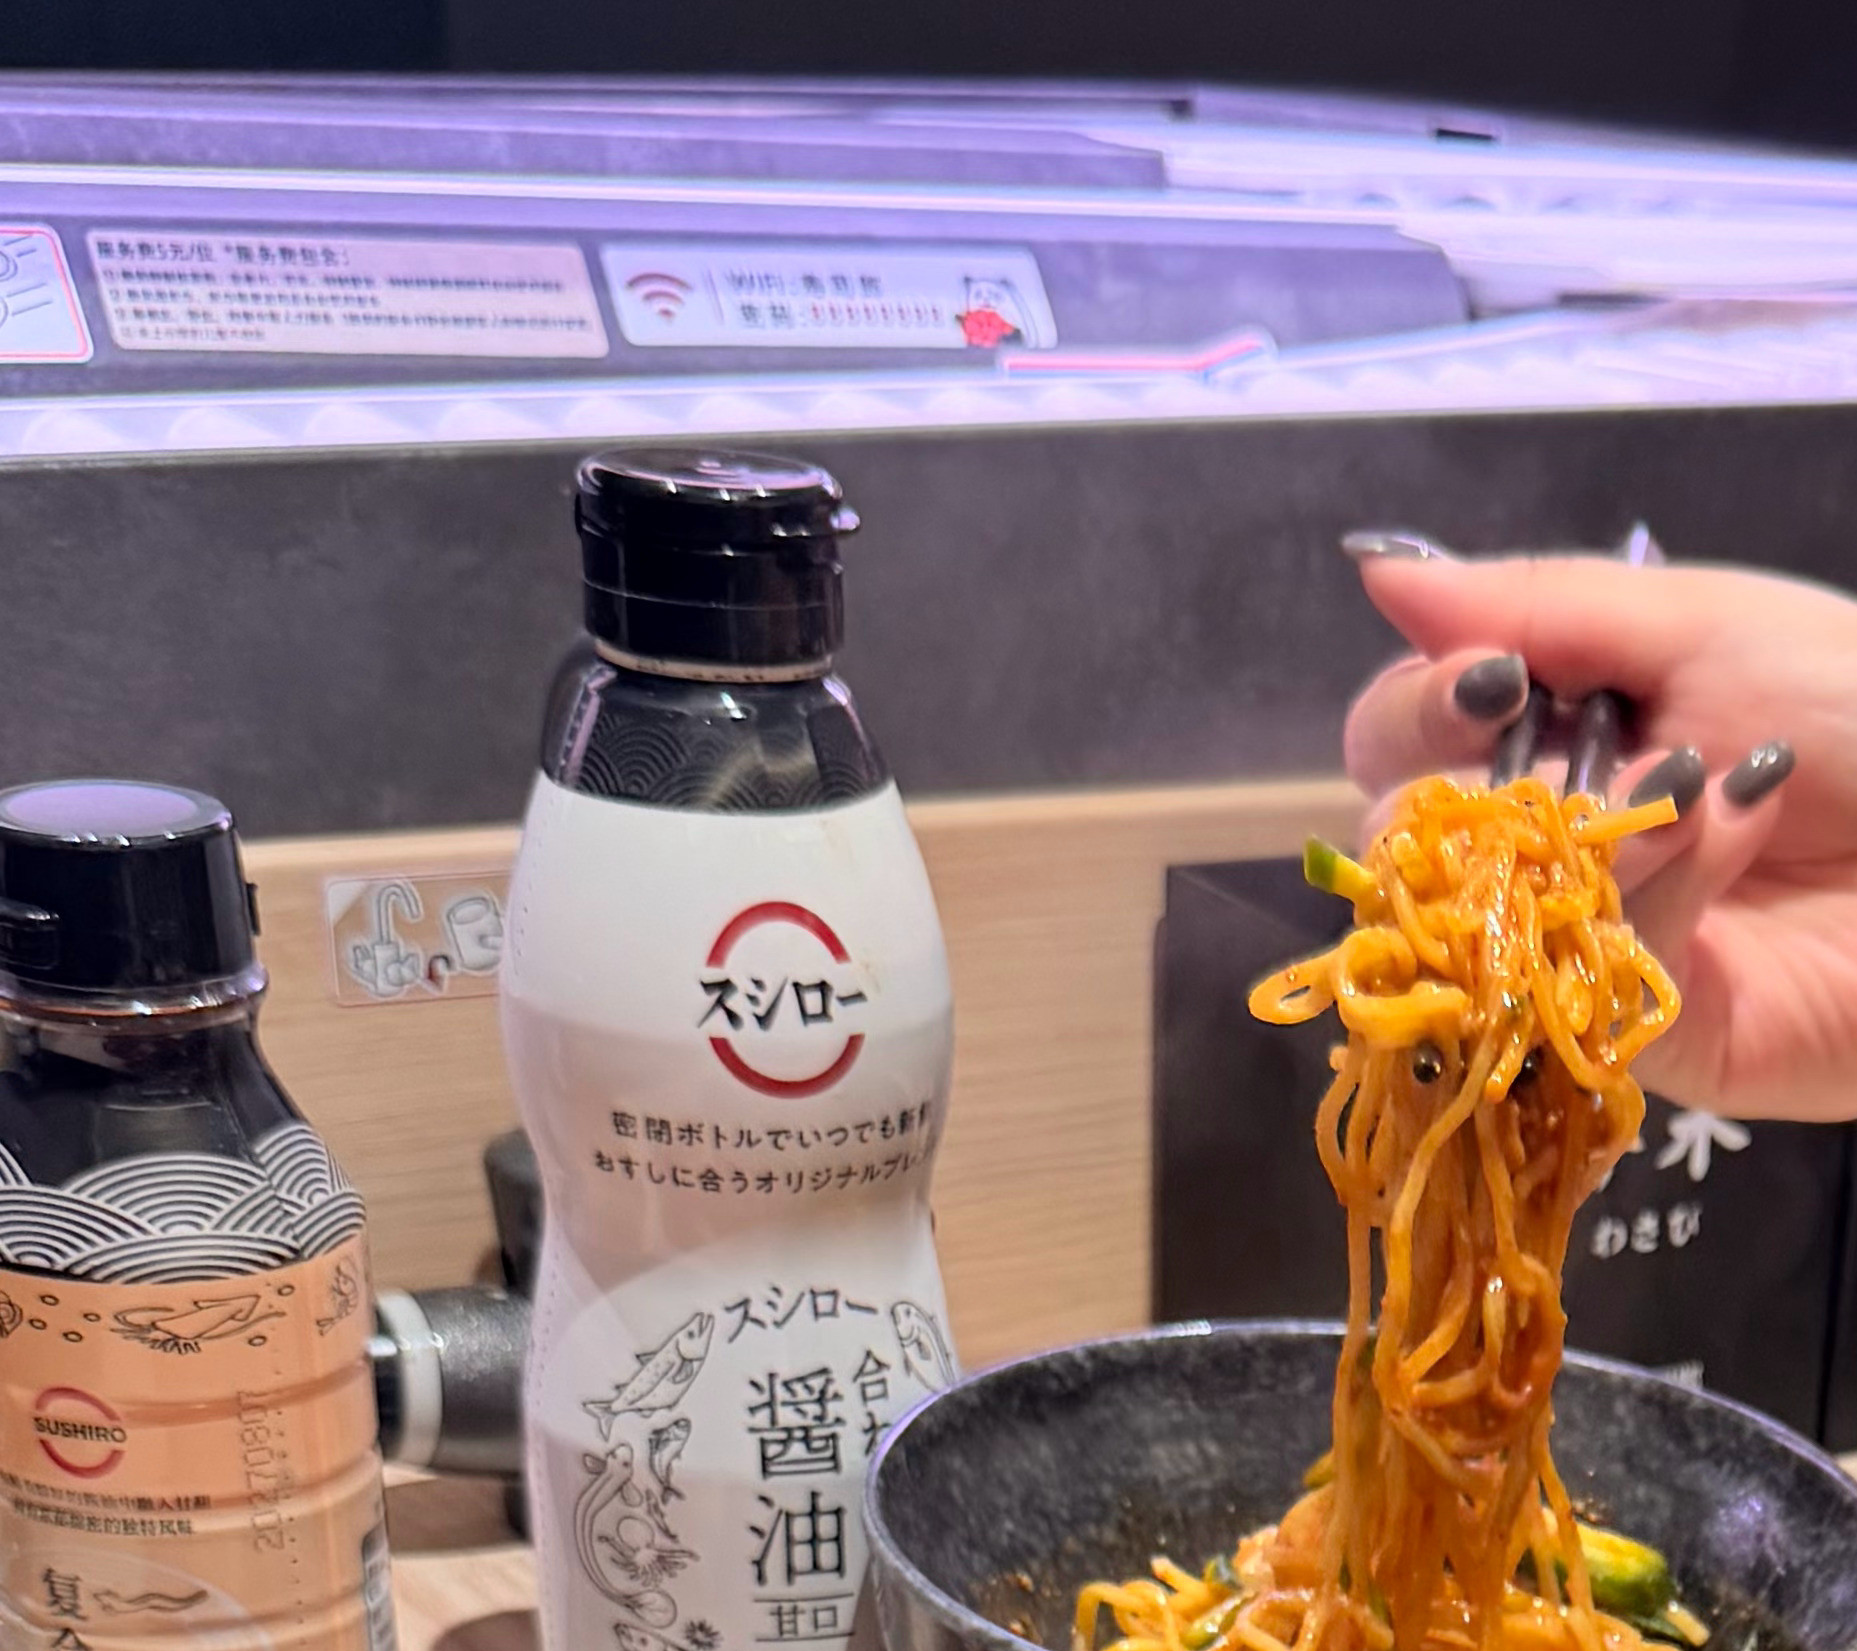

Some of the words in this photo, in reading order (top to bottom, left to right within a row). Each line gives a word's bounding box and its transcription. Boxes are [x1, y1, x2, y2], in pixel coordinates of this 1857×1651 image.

[696, 976, 869, 1032] スシロー
[723, 1283, 882, 1345] スシロー
[33, 1415, 128, 1444] SUSHIRO
[769, 1604, 838, 1637] 甘口
